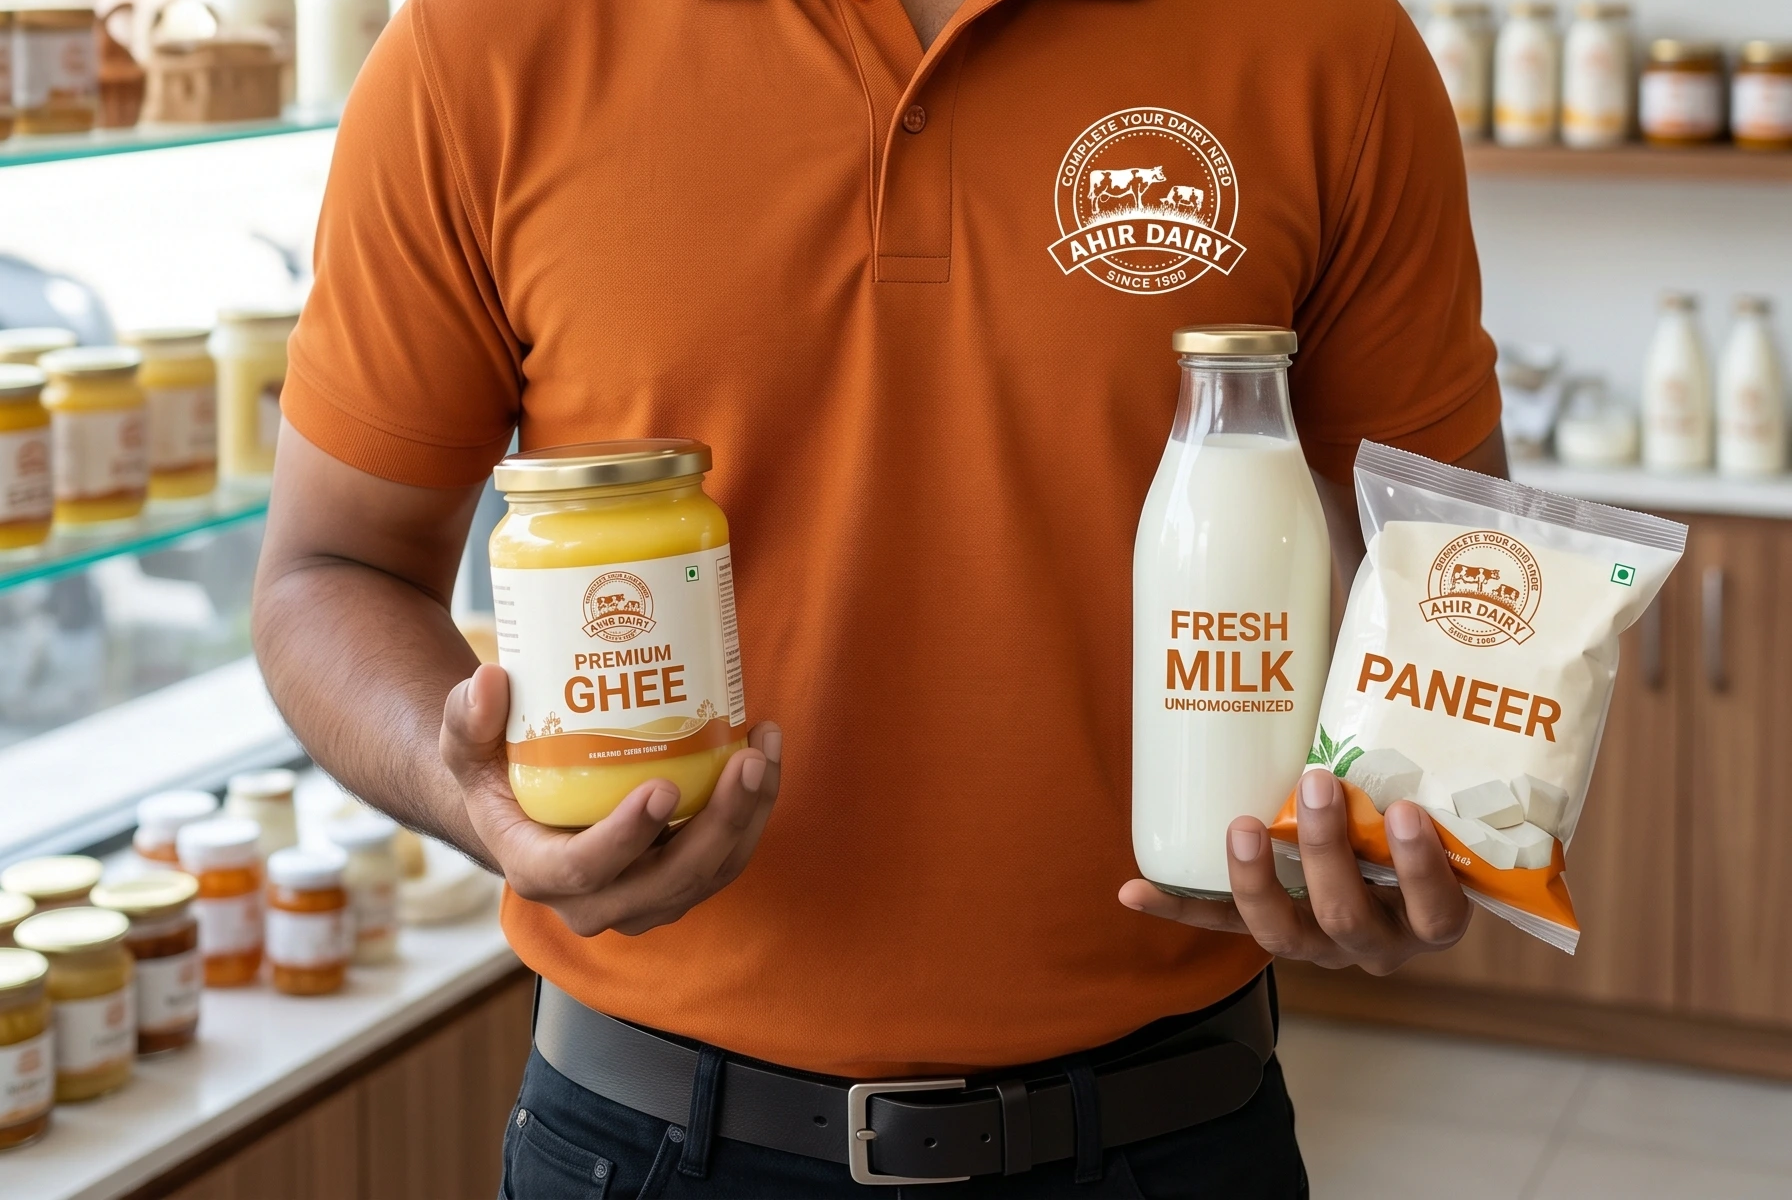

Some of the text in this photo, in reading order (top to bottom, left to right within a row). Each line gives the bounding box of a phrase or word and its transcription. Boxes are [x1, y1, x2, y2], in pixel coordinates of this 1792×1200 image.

[1061, 113, 1232, 187] COMPLETE YOUR DAIRY NEED
[1069, 223, 1232, 262] AHIR DAIRY
[1106, 270, 1150, 288] SINCE
[1483, 534, 1509, 546] YOUR
[618, 616, 649, 628] DAIRY
[1171, 610, 1288, 641] FRESH
[1431, 600, 1526, 636] AHIR DAIRY
[574, 644, 671, 670] PREMIUM
[1166, 649, 1295, 692] MILK
[564, 665, 687, 713] GHEE
[1164, 698, 1294, 713] UNHOMOGENIZED
[1356, 653, 1562, 743] PANEER
